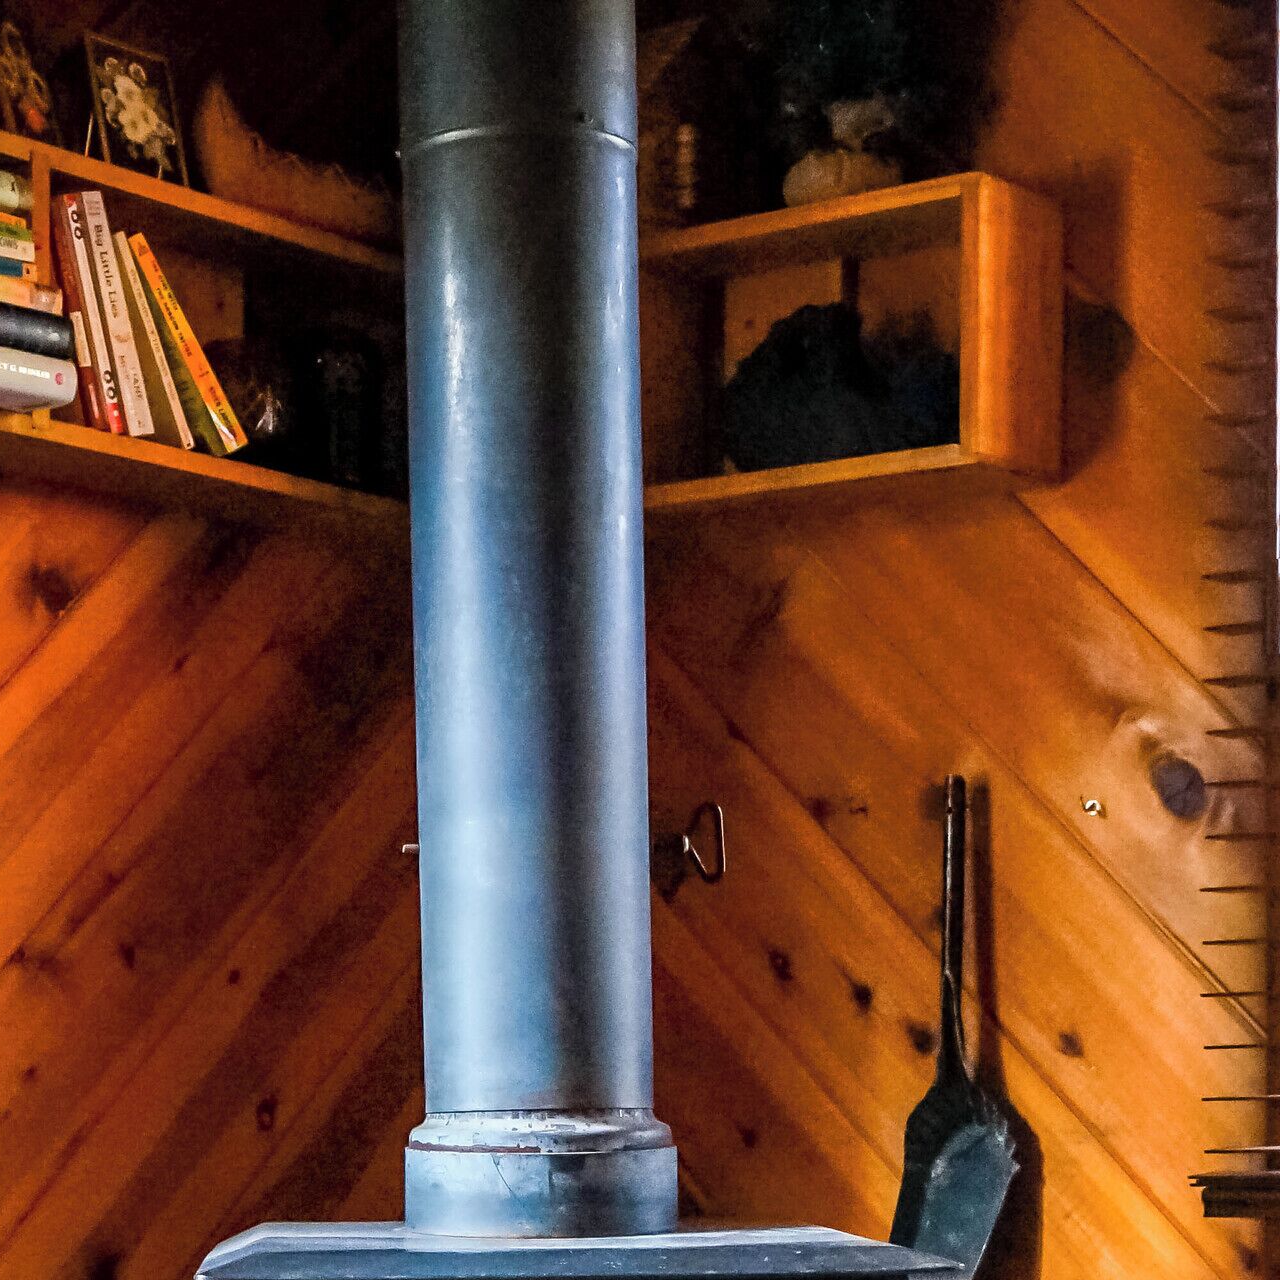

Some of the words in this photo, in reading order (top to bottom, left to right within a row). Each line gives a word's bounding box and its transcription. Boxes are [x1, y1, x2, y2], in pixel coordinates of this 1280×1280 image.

[93, 224, 103, 247] Big
[99, 250, 113, 291] Little
[107, 291, 119, 320] Lies
